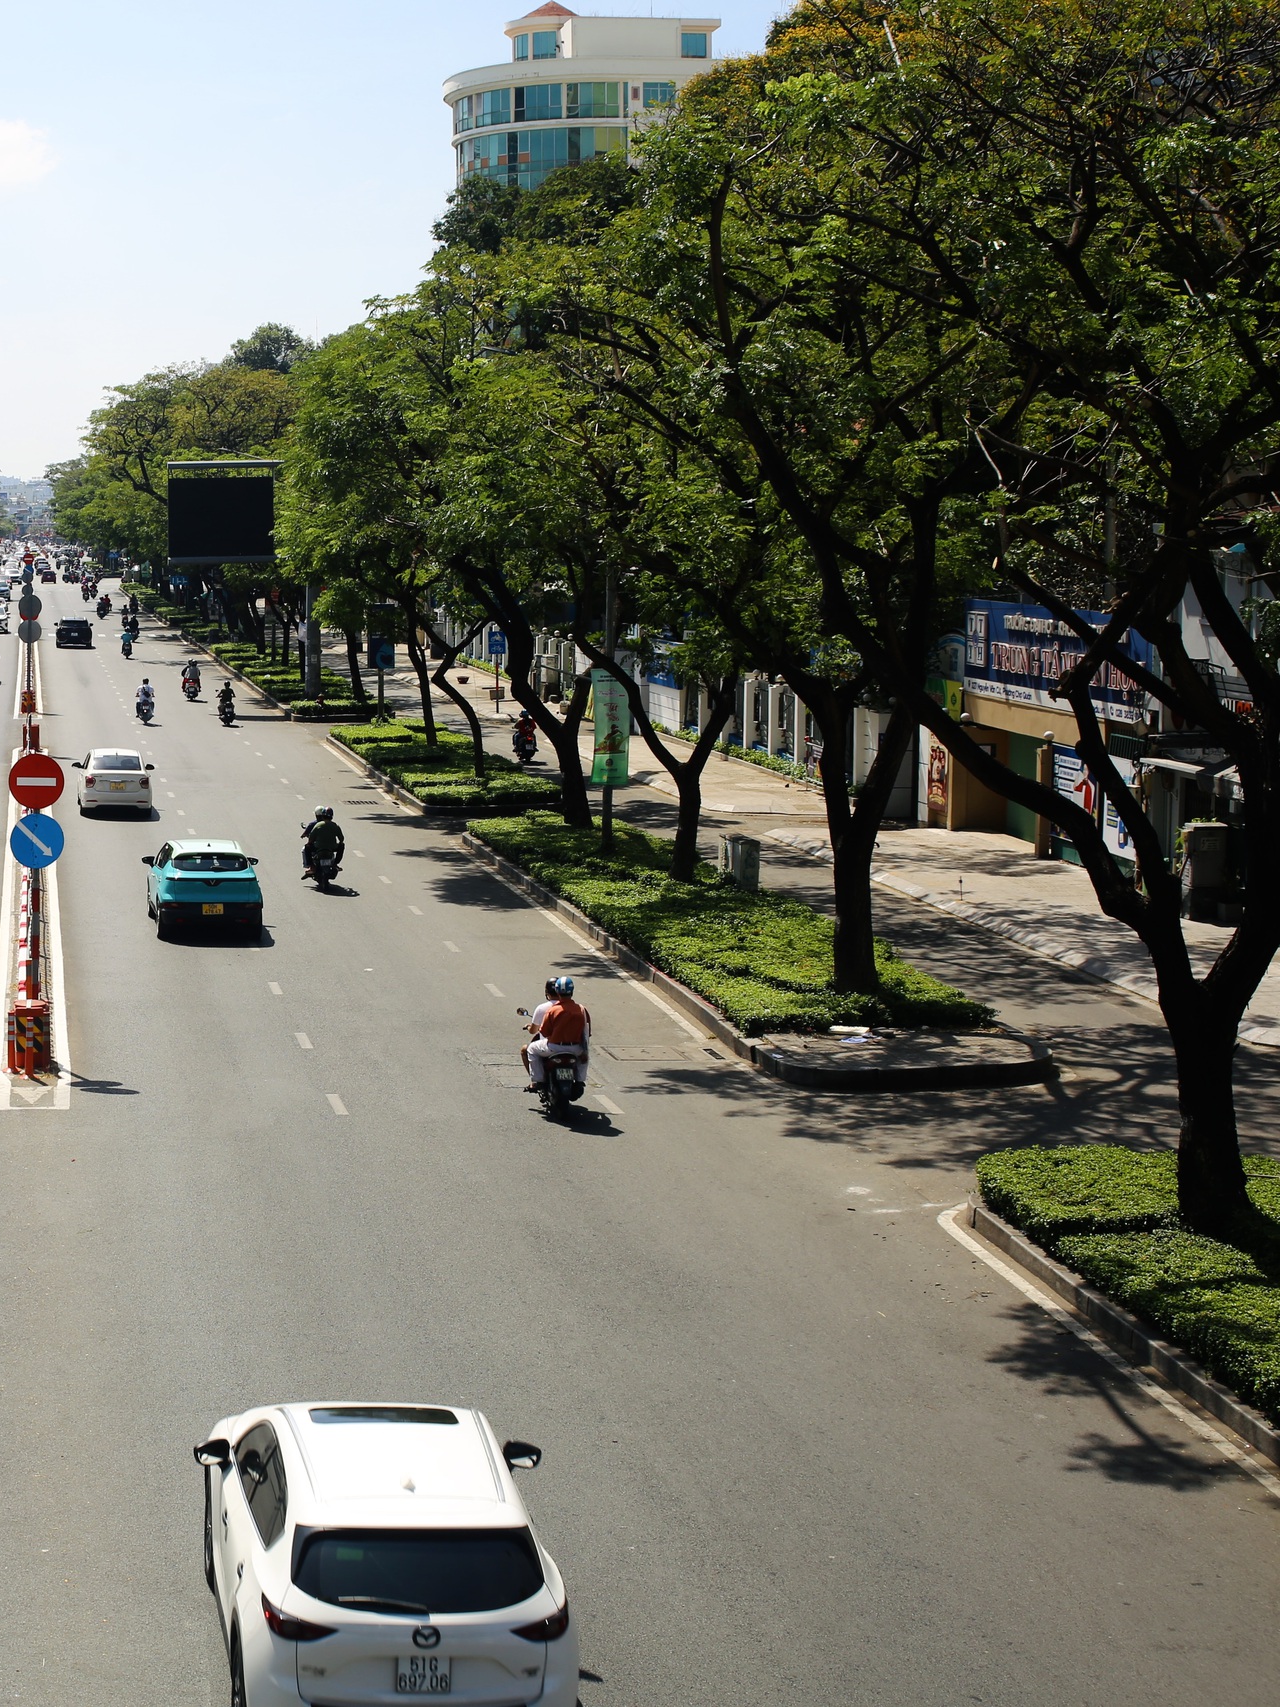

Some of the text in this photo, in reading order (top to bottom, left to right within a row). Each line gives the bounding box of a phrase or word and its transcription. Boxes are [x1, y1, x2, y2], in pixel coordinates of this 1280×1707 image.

[991, 642, 1041, 677] TRUNG
[410, 1656, 439, 1674] 51G
[399, 1673, 449, 1691] 697.06
